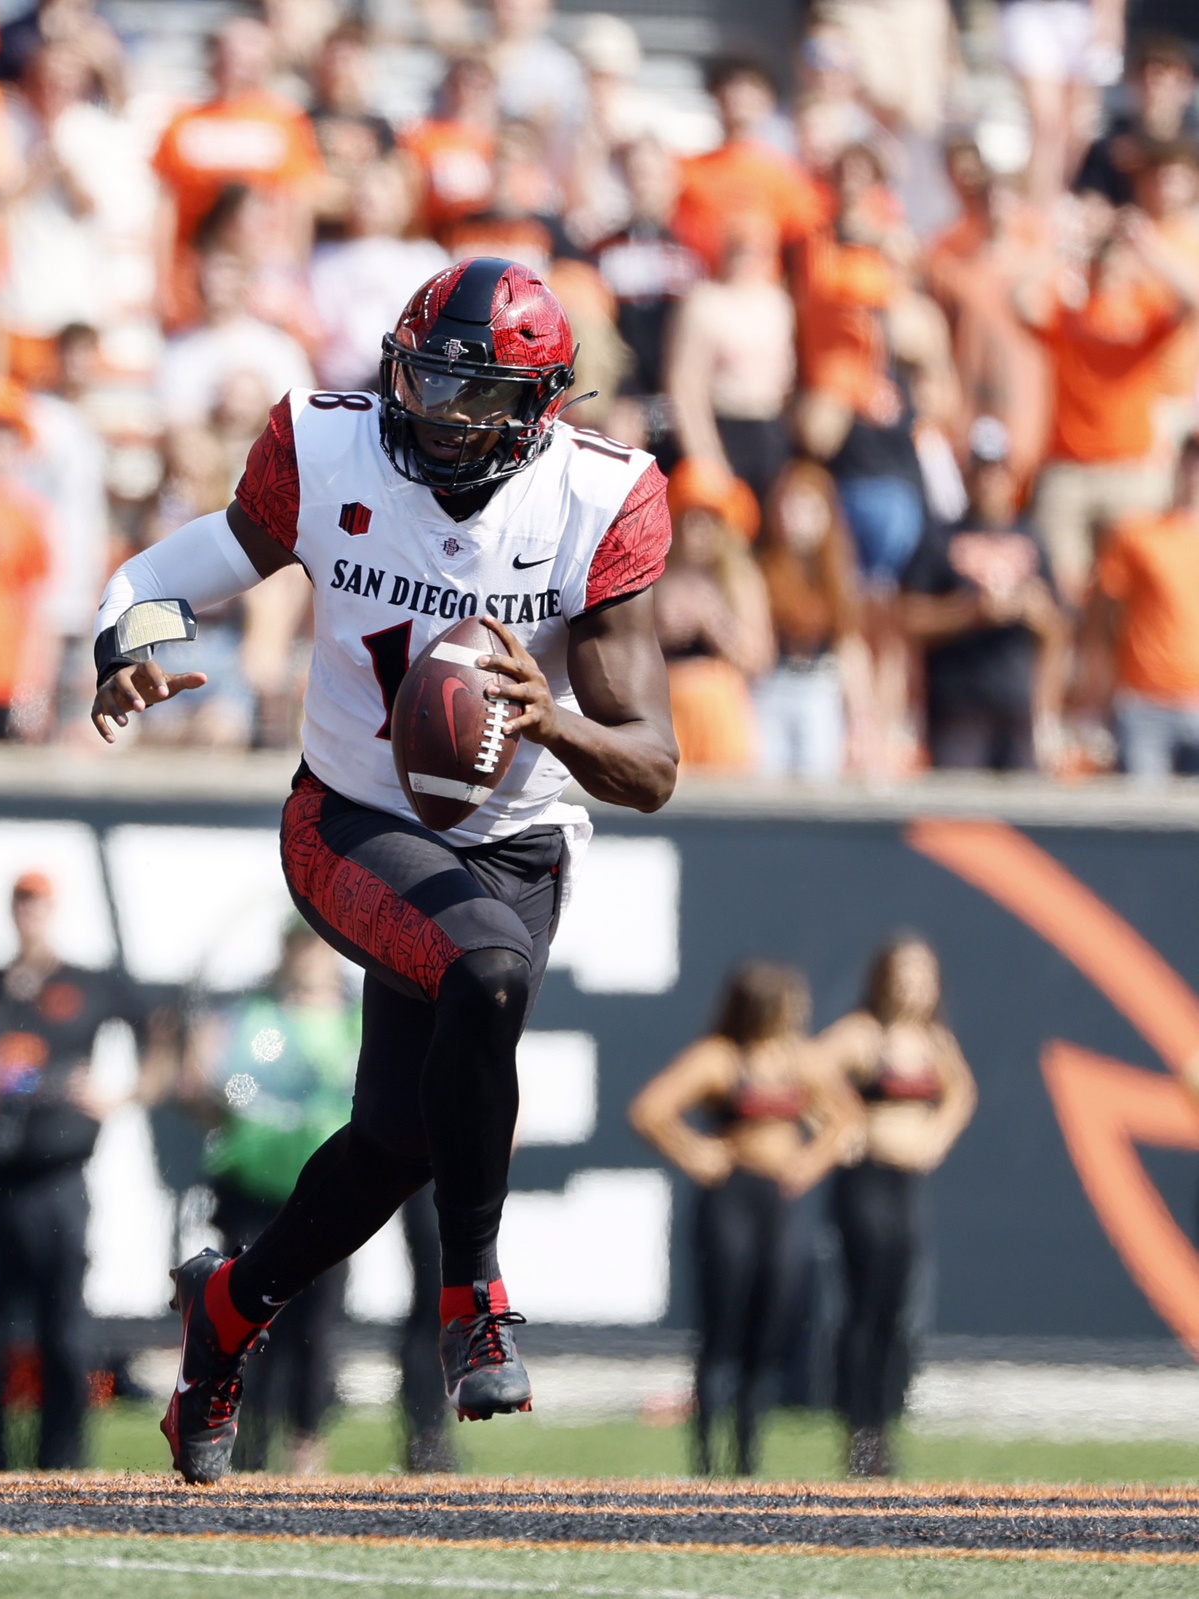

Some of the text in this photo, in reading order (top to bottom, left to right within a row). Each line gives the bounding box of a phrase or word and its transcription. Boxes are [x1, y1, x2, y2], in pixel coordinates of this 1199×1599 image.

[330, 558, 562, 625] SAN DIEGO STATE
